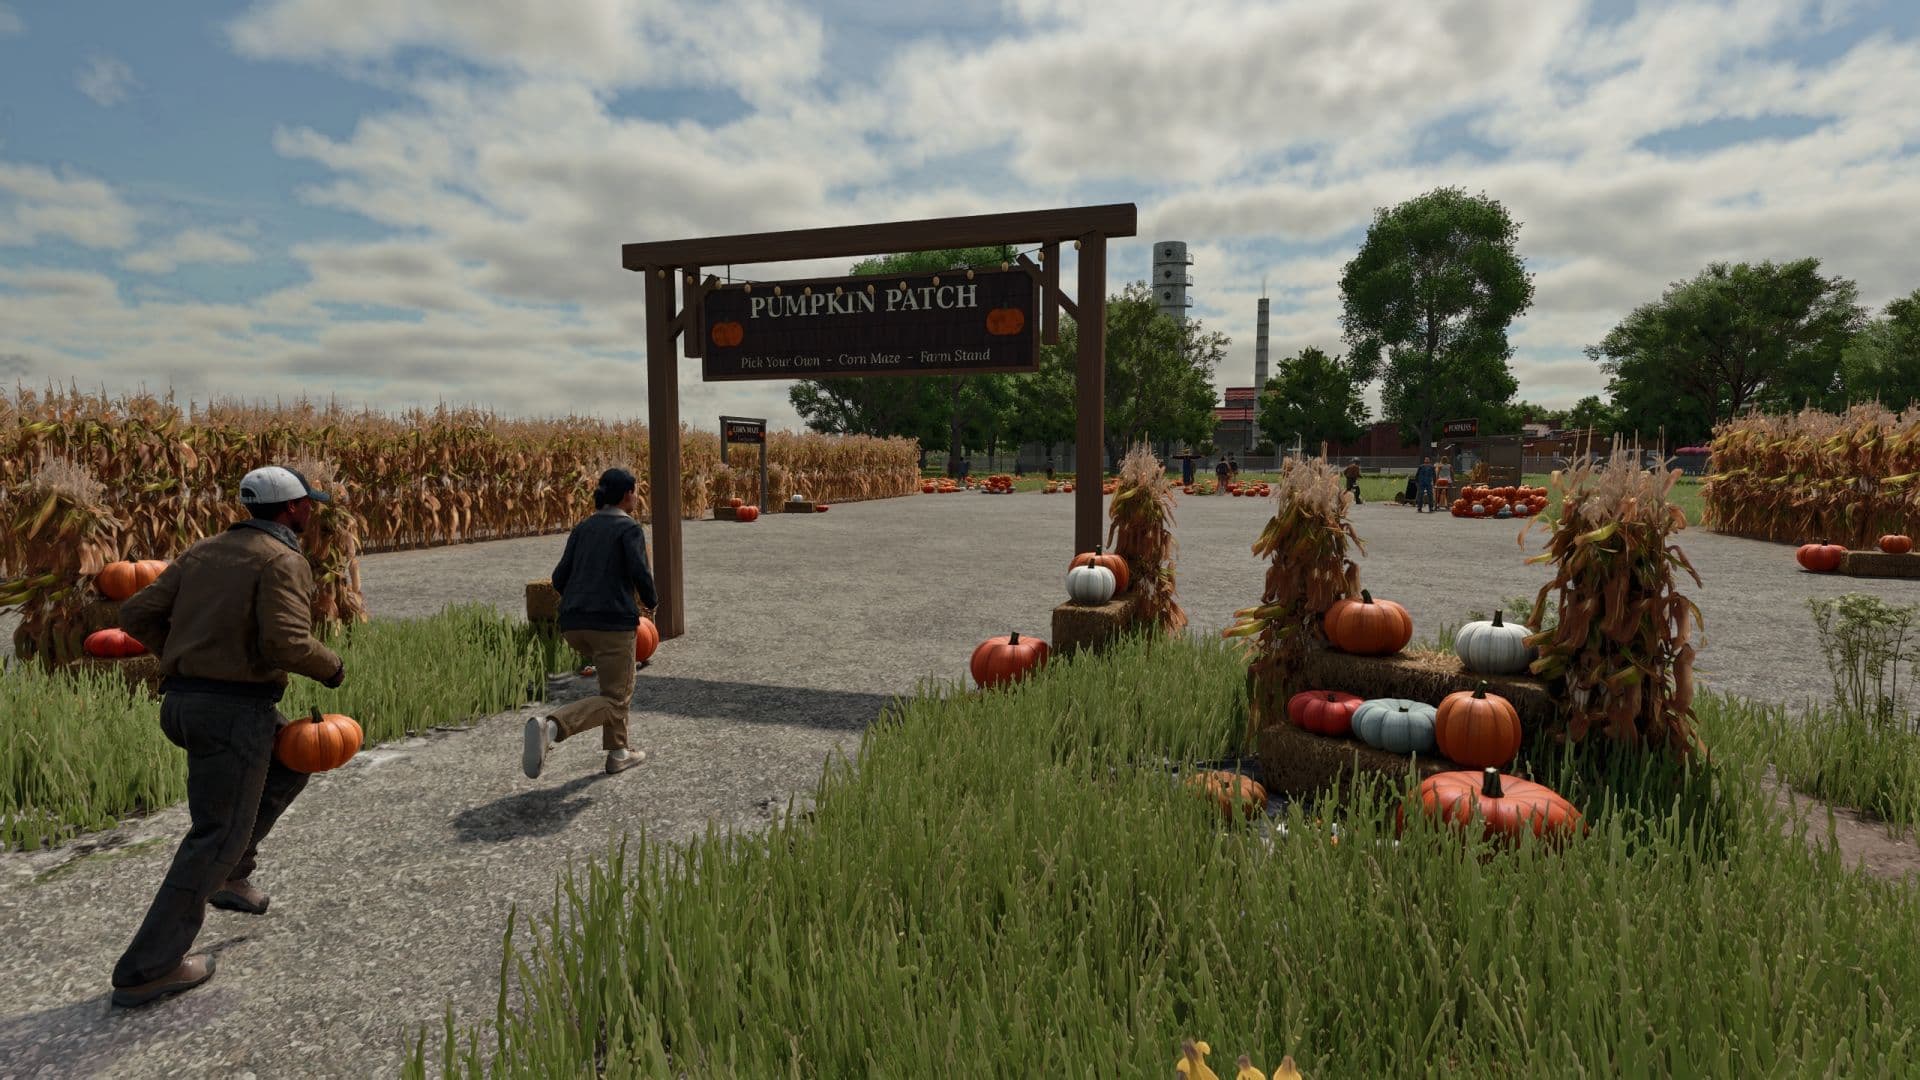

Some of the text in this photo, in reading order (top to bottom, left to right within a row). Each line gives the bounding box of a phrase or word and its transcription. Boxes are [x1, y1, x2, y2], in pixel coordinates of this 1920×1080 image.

[750, 284, 978, 318] PUMPKIN PATCH
[741, 356, 763, 369] Pick
[766, 357, 791, 368] Your
[794, 355, 820, 367] Own
[838, 353, 867, 366] Corn
[871, 352, 901, 364] Maze
[920, 350, 950, 362] Farm
[955, 348, 991, 362] Stand
